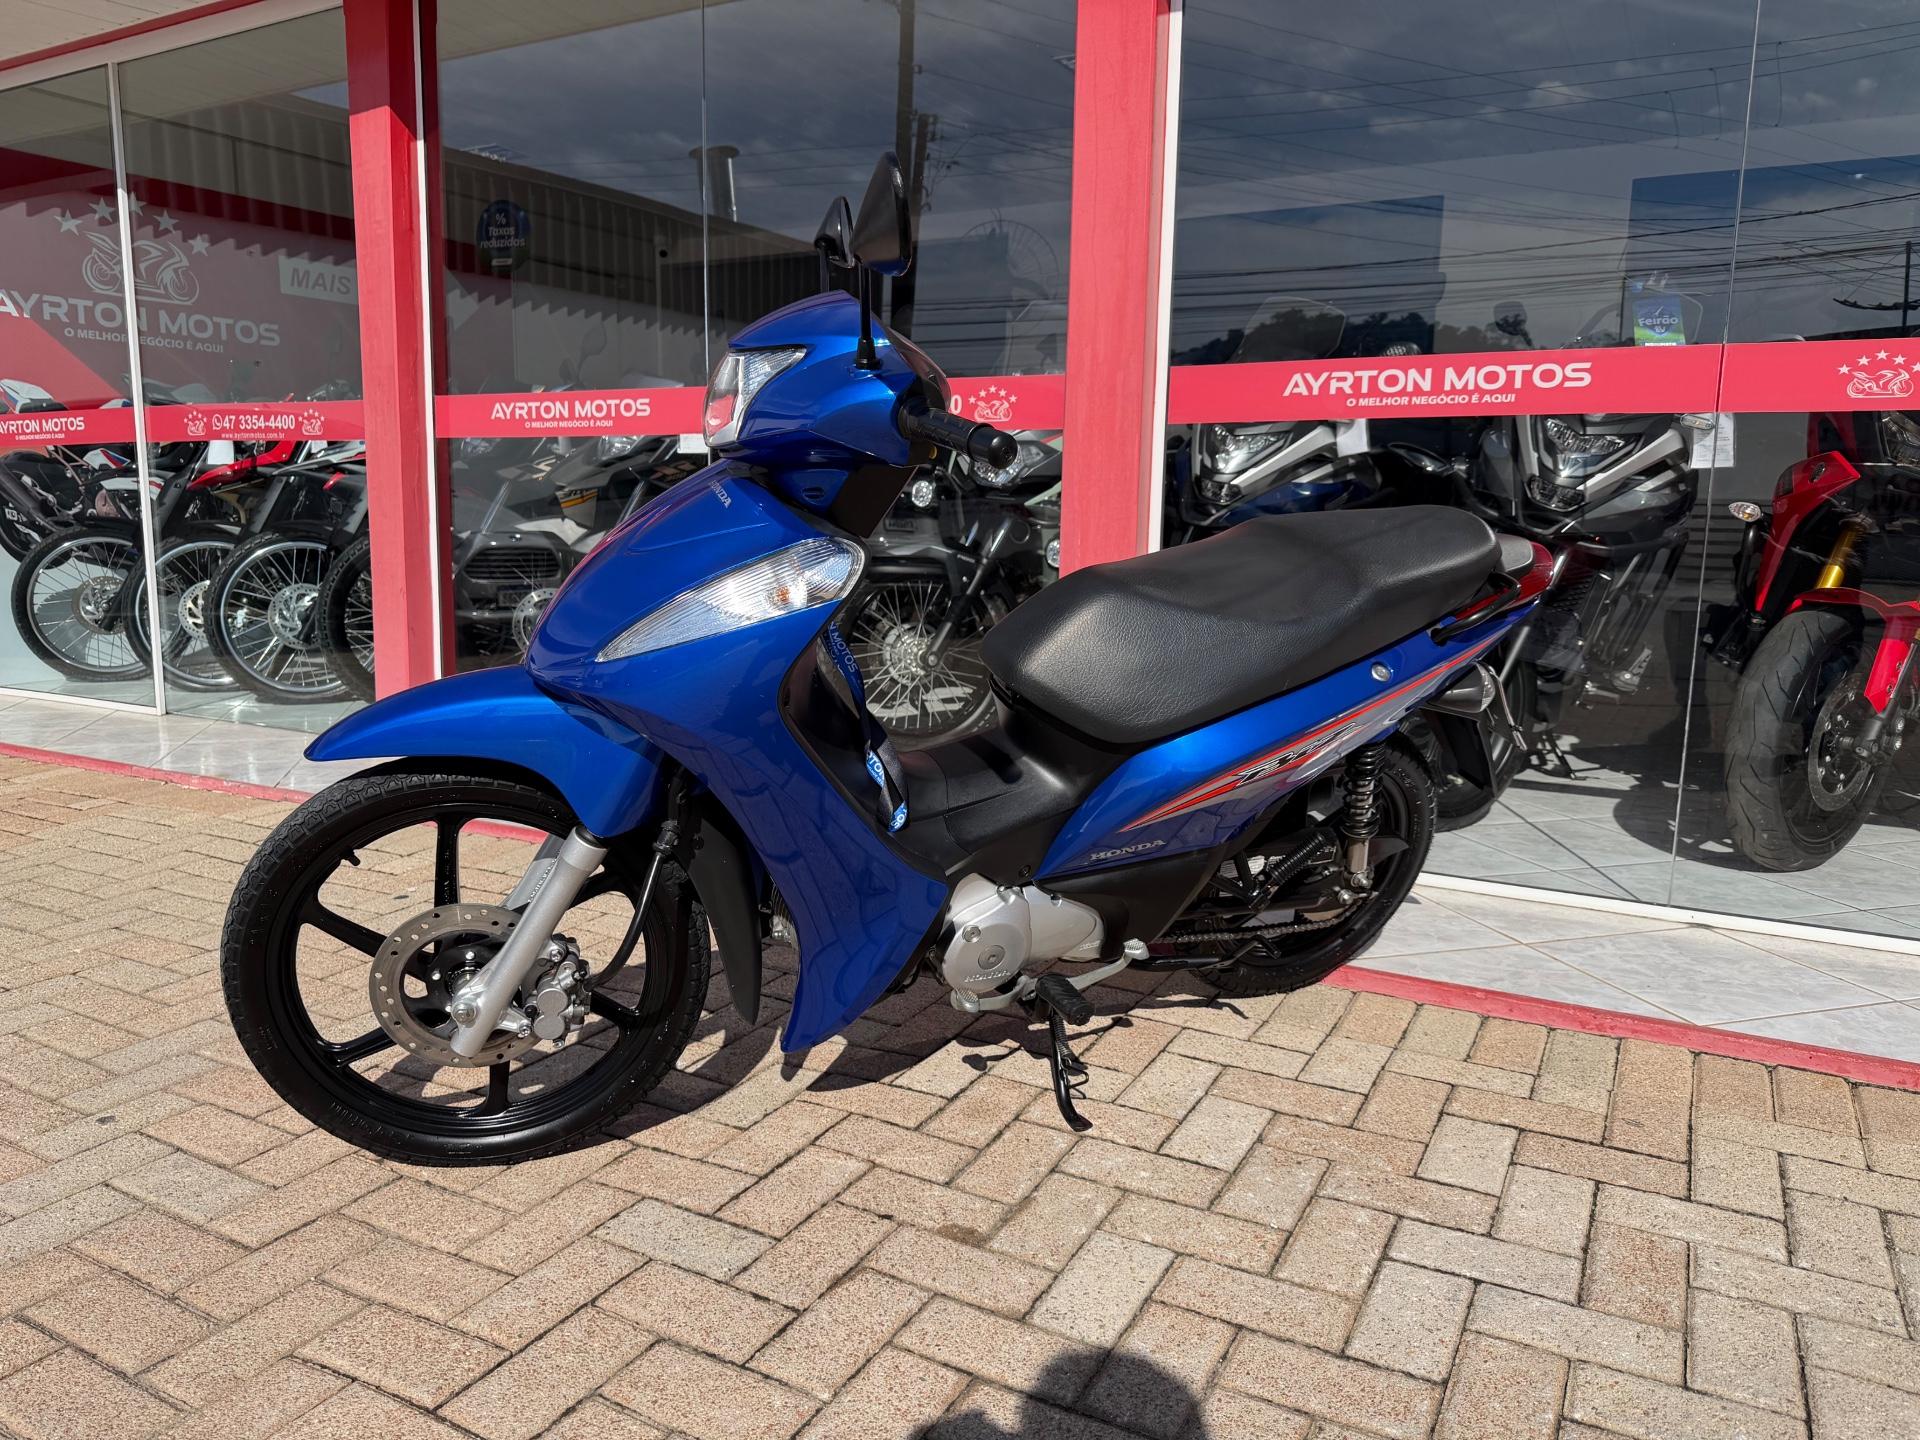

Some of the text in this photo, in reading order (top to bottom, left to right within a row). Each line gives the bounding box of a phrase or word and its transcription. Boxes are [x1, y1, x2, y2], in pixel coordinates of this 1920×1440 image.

[488, 226, 515, 236] Taxas
[290, 267, 351, 295] MAIS
[158, 309, 281, 346] MOTOS
[1638, 315, 1679, 327] Feirão
[64, 327, 74, 337] O
[139, 335, 185, 349] EGÓCIO
[195, 342, 224, 353] AQUI
[1282, 362, 1592, 397] AYRTON MOTOS
[1346, 392, 1516, 407] O MELHOR NEGÓCIO É AQUI
[490, 398, 651, 420] AYRTON MOTOS
[42, 416, 85, 432] MOTOS
[223, 414, 296, 430] 47 3354-4400
[525, 421, 531, 429] O
[531, 420, 558, 429] MELHOR
[559, 419, 589, 428] NEGÓCIO
[595, 419, 613, 428] AQUI
[1090, 840, 1167, 861] HONDA
